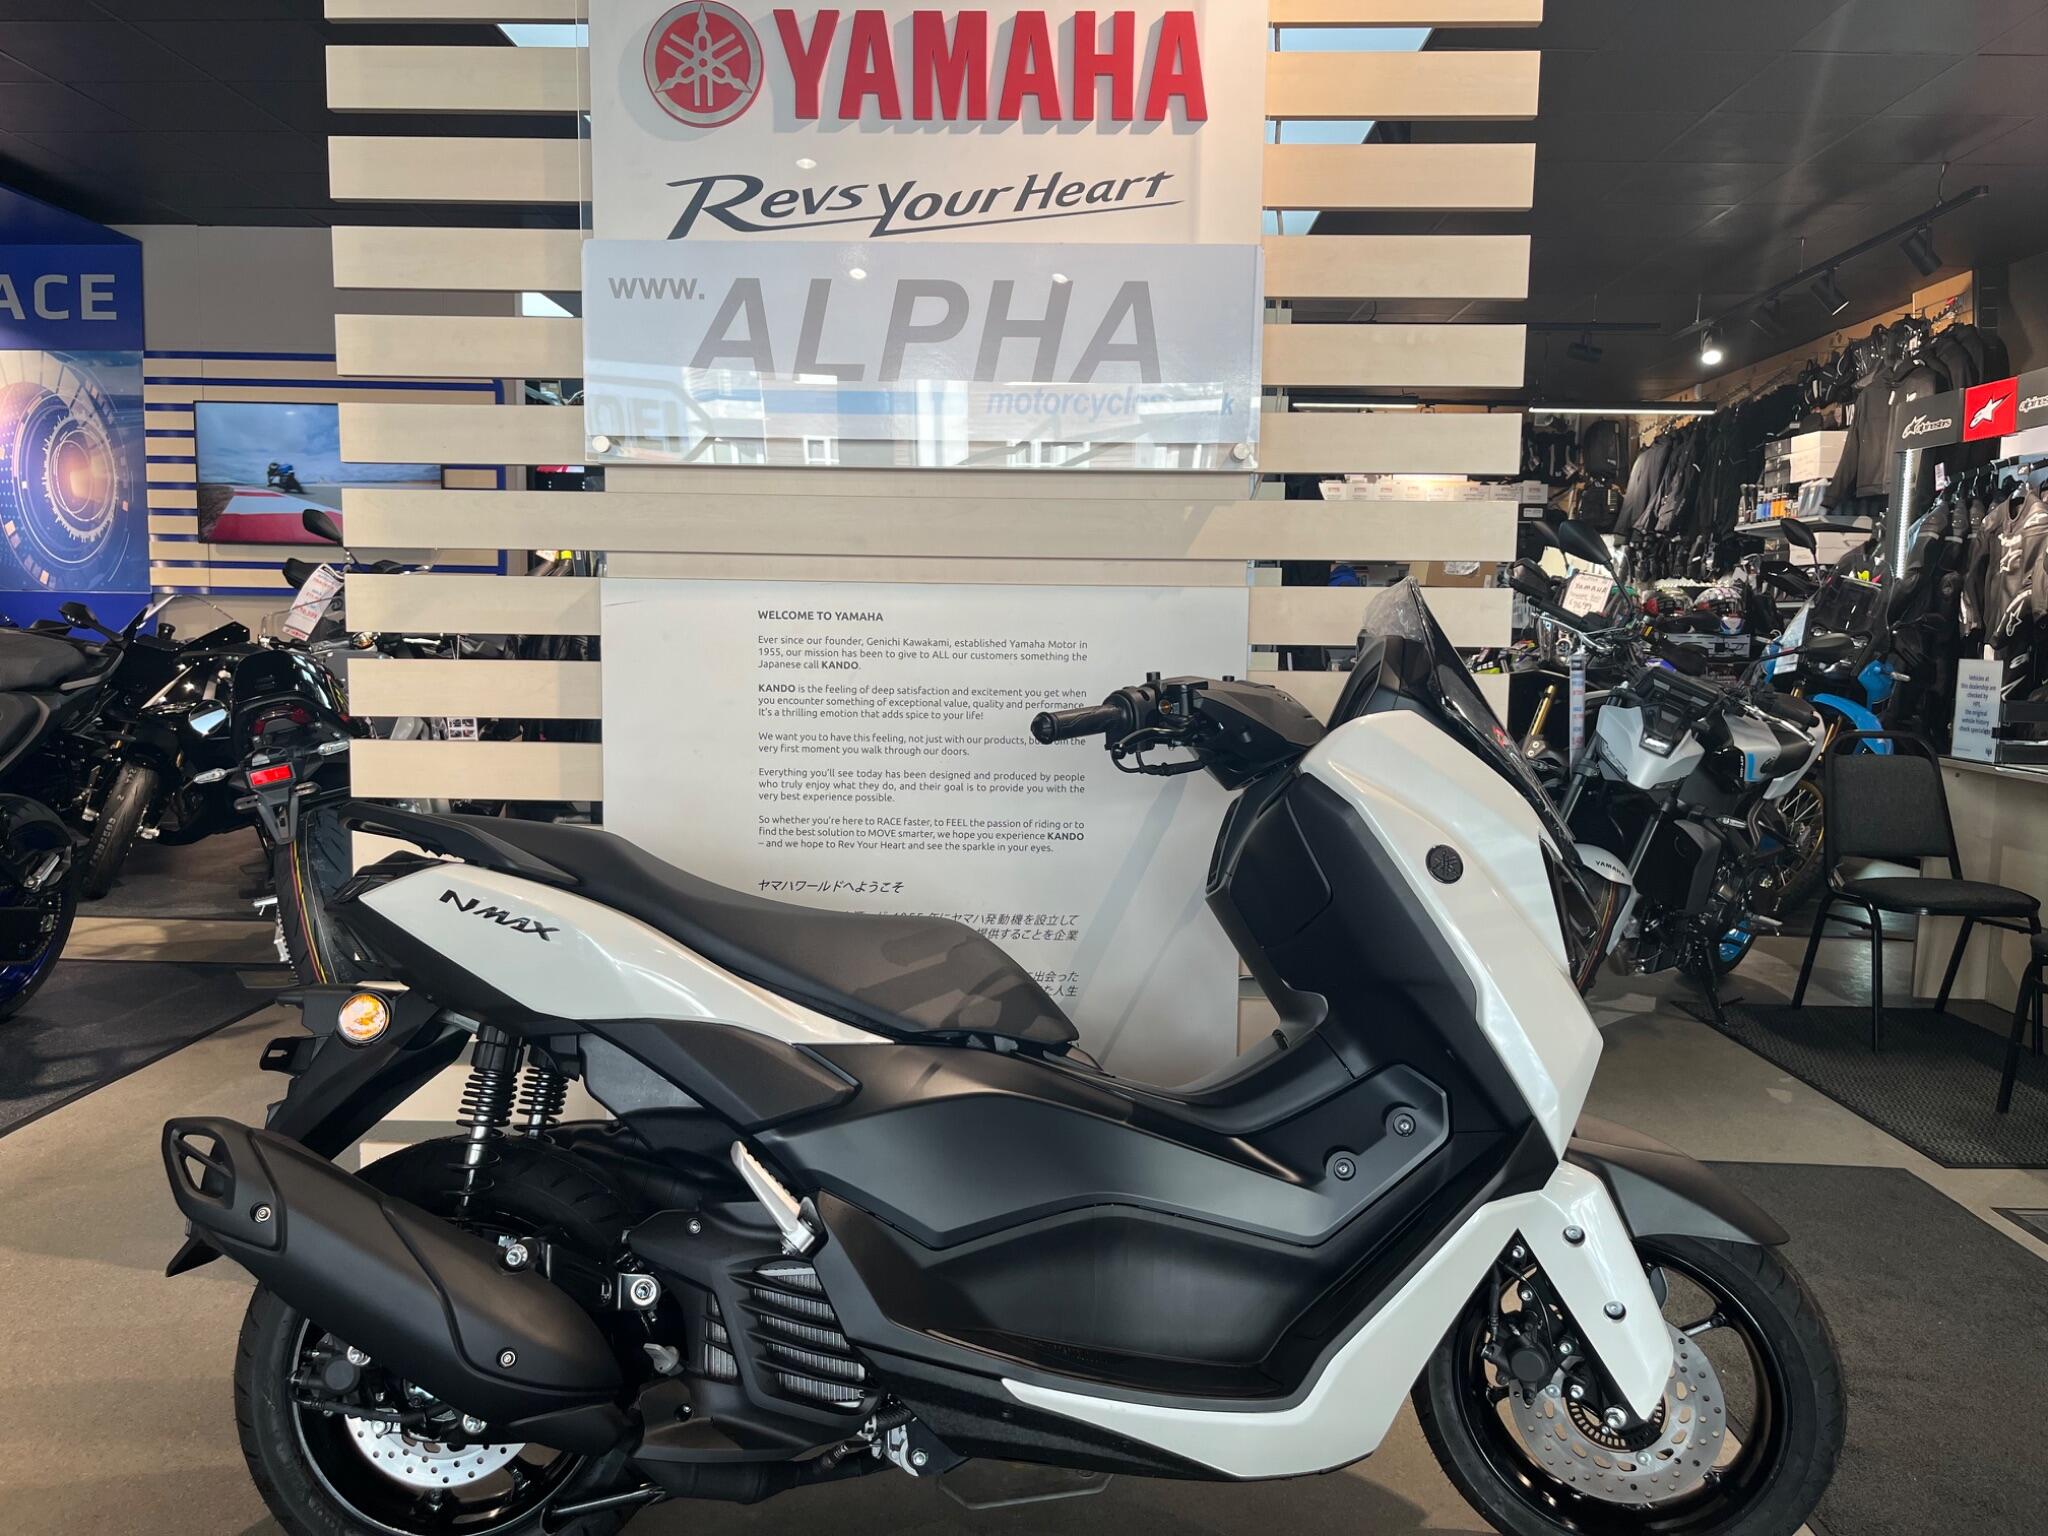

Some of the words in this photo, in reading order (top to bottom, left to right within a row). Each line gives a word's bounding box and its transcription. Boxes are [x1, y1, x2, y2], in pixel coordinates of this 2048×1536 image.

[773, 9, 1208, 121] YAMAHA
[666, 172, 869, 239] Revs
[870, 179, 1014, 237] Your
[1013, 170, 1175, 212] Heart
[608, 277, 706, 300] www.
[688, 277, 1162, 384] ALPHA
[758, 610, 814, 621] WELCOME
[816, 611, 832, 621] TO
[835, 612, 884, 621] YAMAHA
[758, 635, 778, 644] Ever
[780, 635, 805, 645] since
[825, 636, 864, 647] founder,
[866, 637, 901, 647] Genichi
[903, 638, 952, 648] Kawakami,
[954, 639, 1007, 648] established
[1009, 639, 1045, 649] Yamaha
[1047, 640, 1078, 649] Motor
[1079, 641, 1088, 649] in
[759, 647, 784, 658] 1955,
[785, 649, 803, 657] our
[804, 648, 839, 658] mission
[841, 648, 858, 658] has
[859, 649, 883, 658] been
[885, 650, 896, 658] to
[897, 650, 917, 660] give
[919, 650, 930, 659] to
[932, 650, 950, 659] ALL
[952, 652, 968, 660] our
[970, 652, 1018, 661] customers
[1020, 651, 1069, 663] something
[1072, 652, 1088, 661] the
[758, 660, 802, 671] Japanese
[803, 660, 819, 670] call
[758, 684, 796, 693] KANDO
[797, 684, 806, 694] is
[807, 684, 823, 694] the
[825, 684, 857, 696] feeling
[859, 684, 870, 695] of
[871, 686, 895, 696] deep
[896, 686, 950, 696] satisfaction
[951, 687, 969, 696] and
[971, 688, 1023, 697] excitement
[1024, 690, 1042, 699] you
[1043, 689, 1060, 699] get
[1061, 688, 1087, 698] when
[758, 697, 775, 706] you
[777, 696, 825, 706] encounter
[826, 697, 875, 708] something
[876, 697, 888, 707] of
[888, 698, 942, 709] exceptional
[943, 699, 971, 709] value,
[972, 699, 1004, 710] quality
[1005, 700, 1023, 709] and
[758, 707, 772, 717] It's
[774, 709, 780, 717] a
[781, 708, 818, 719] thrilling
[820, 708, 859, 718] emotion
[860, 709, 880, 719] that
[881, 709, 904, 719] adds
[904, 710, 929, 721] spice
[931, 711, 941, 720] to
[943, 712, 964, 721] your
[966, 710, 983, 720] life!
[758, 732, 773, 741] We
[775, 733, 798, 741] want
[799, 734, 817, 743] you
[818, 733, 829, 742] to
[830, 732, 852, 742] have
[853, 733, 871, 743] this
[872, 733, 907, 744] feeling,
[908, 735, 924, 743] not
[924, 735, 943, 745] just
[944, 734, 965, 744] with
[984, 735, 1027, 746] products,
[1070, 737, 1086, 746] the
[759, 767, 808, 779] Everything
[810, 768, 835, 779] you'll
[837, 770, 854, 778] see
[856, 769, 883, 780] today
[885, 769, 901, 779] has
[903, 770, 927, 779] been
[929, 771, 971, 781] designed
[973, 771, 992, 780] and
[993, 772, 1037, 782] produced
[1039, 772, 1051, 782] by
[1053, 773, 1085, 783] people
[758, 793, 779, 802] very
[780, 791, 801, 801] best
[802, 794, 853, 802] experience
[855, 792, 895, 803] possible.
[759, 815, 770, 824] So
[771, 815, 810, 825] whether
[812, 816, 841, 827] you're
[842, 816, 864, 826] here
[865, 818, 875, 826] to
[877, 817, 902, 826] RACE
[903, 817, 932, 828] faster,
[934, 819, 944, 827] to
[946, 818, 969, 827] FEEL
[969, 819, 985, 828] the
[987, 820, 1021, 830] passion
[1022, 819, 1033, 828] of
[1034, 820, 1061, 830] riding
[1074, 821, 1085, 829] to
[766, 839, 783, 848] and
[800, 839, 824, 849] hope
[826, 840, 836, 849] to
[838, 840, 855, 849] Rev
[856, 840, 879, 849] Your
[880, 841, 906, 850] Heart
[908, 841, 925, 850] and
[945, 842, 960, 851] the
[962, 842, 995, 853] sparkle
[1007, 844, 1028, 854] your
[1030, 845, 1053, 854] eyes.
[1595, 860, 1625, 877] YAMAHA
[757, 879, 905, 894] ヤマハワールドへようこそ
[439, 889, 560, 941] NMAX
